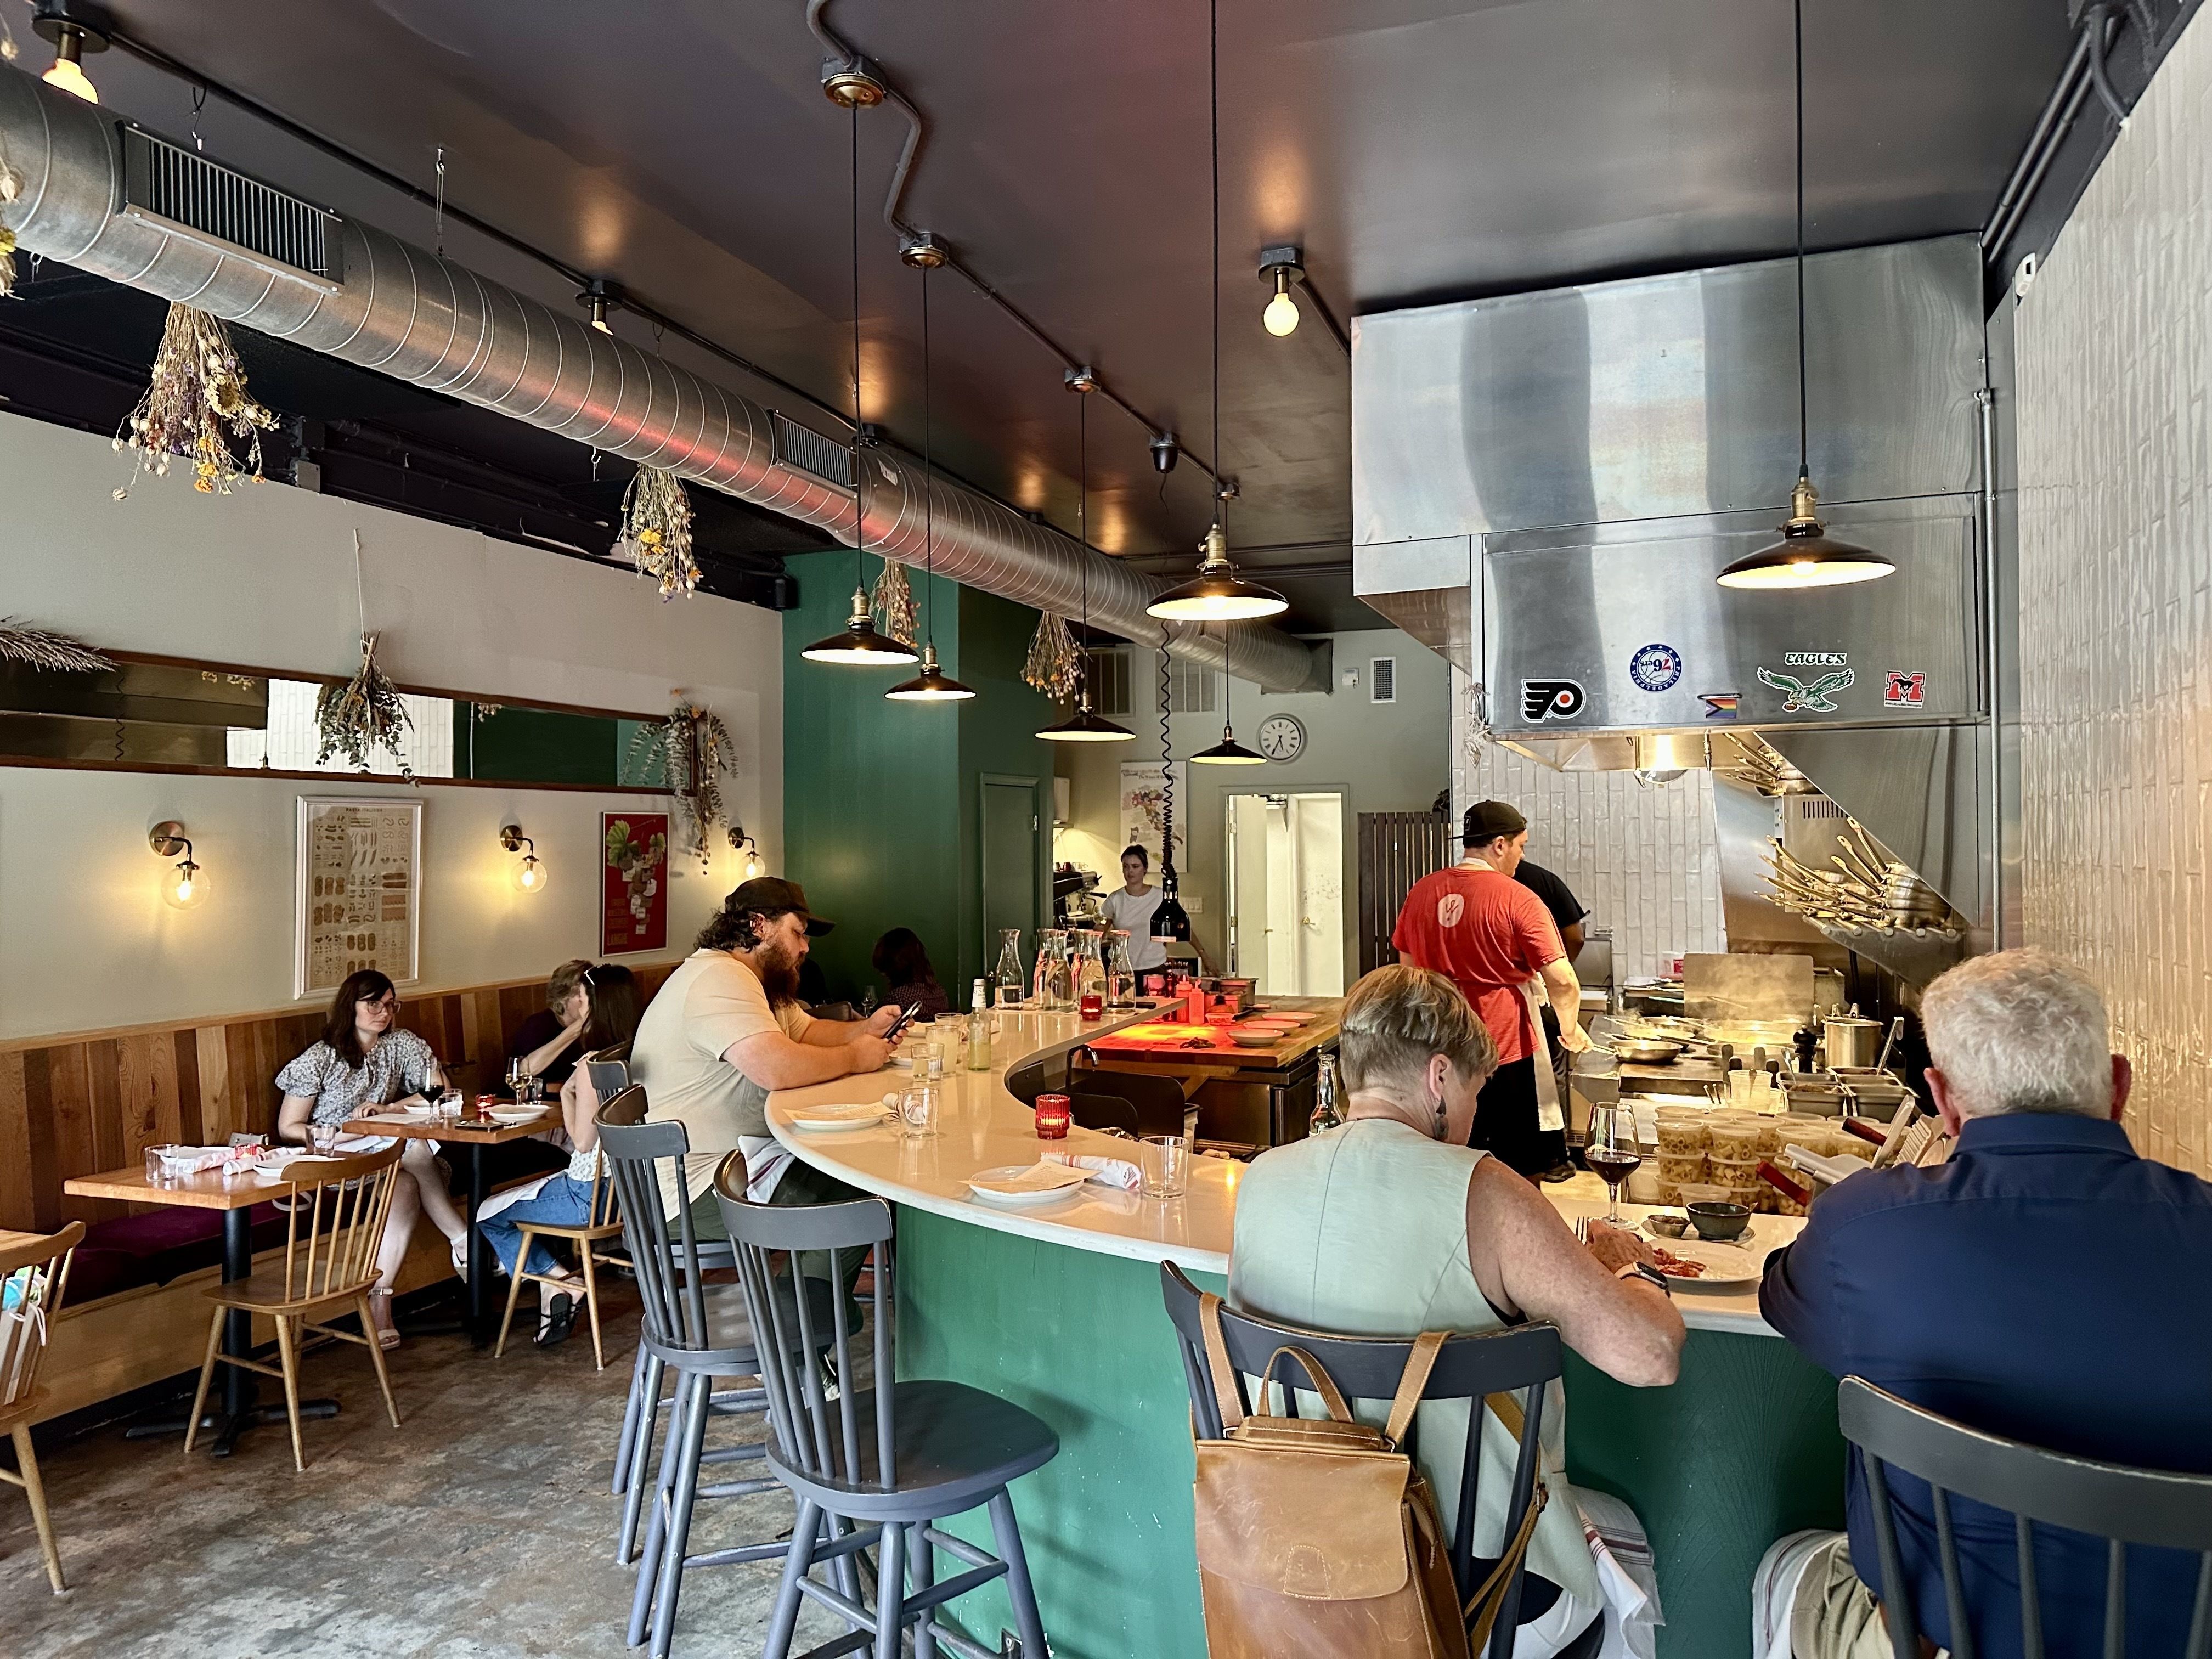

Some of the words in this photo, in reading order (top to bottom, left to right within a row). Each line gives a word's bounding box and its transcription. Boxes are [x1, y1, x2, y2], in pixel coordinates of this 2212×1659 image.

[1640, 658, 1670, 672] 76ers
[1786, 654, 1846, 664] EAGLES
[1631, 665, 1681, 691] PHILADELPHIA
